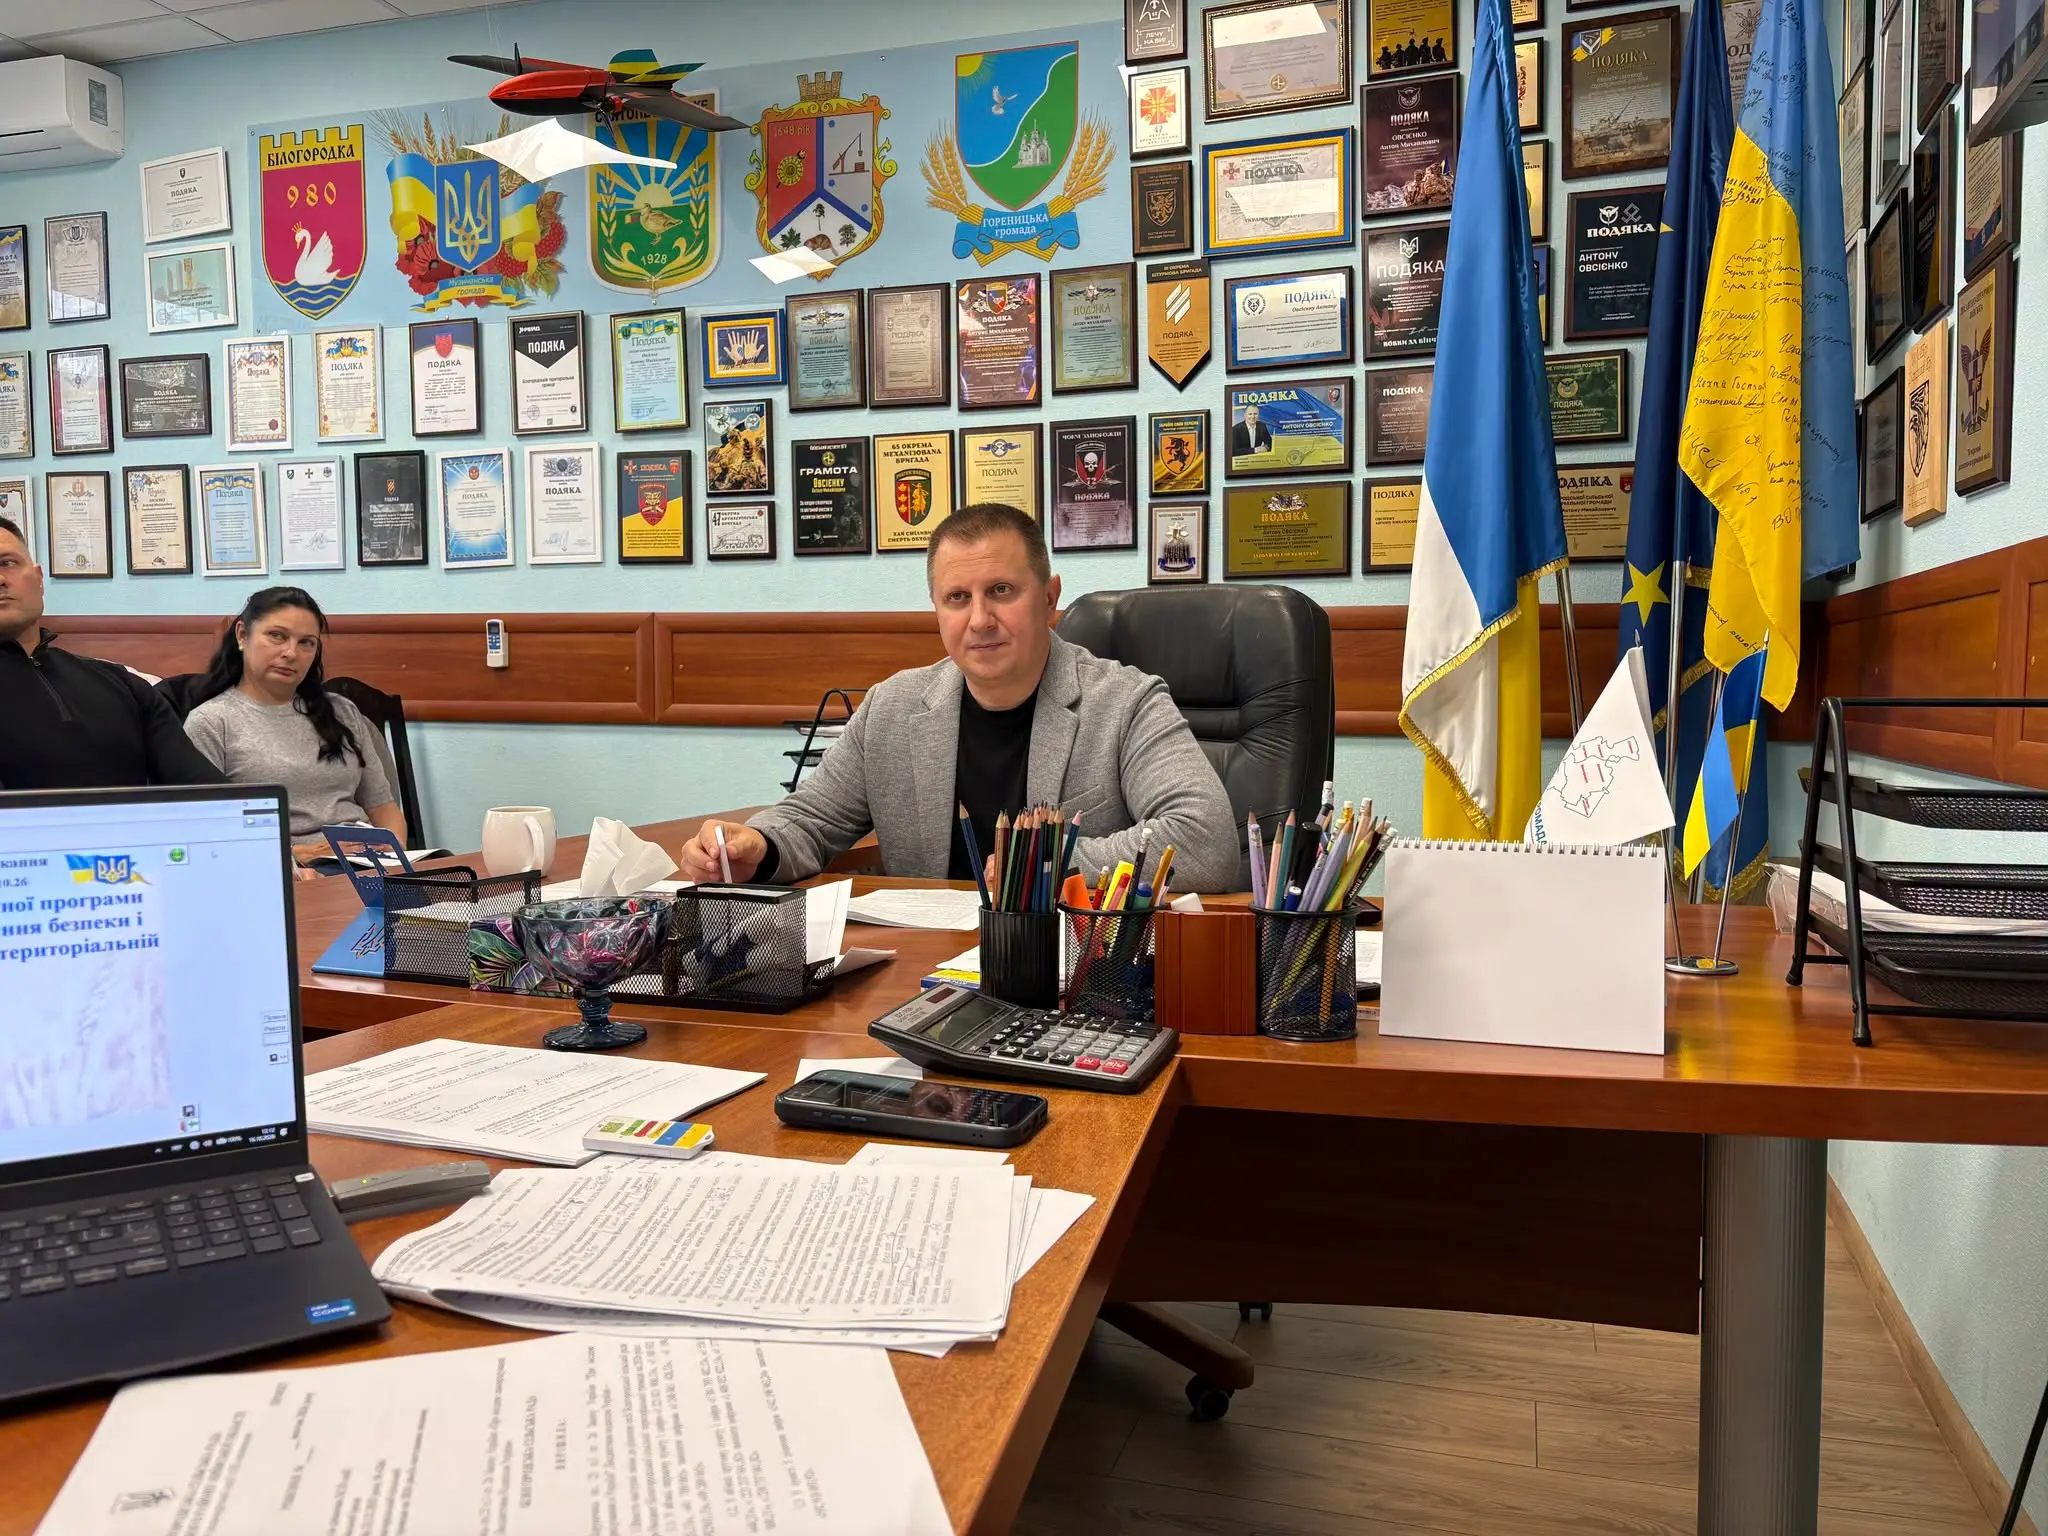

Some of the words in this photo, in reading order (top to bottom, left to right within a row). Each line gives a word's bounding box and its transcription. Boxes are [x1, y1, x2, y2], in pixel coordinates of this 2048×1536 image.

[1590, 50, 1649, 69] ПОДЯКА
[1390, 111, 1430, 126] ПОДЯКА
[774, 125, 795, 137] 1648
[1391, 131, 1428, 141] ОВСІЄНКО
[266, 143, 356, 168] БІЛОГОРОДКА
[1244, 164, 1305, 180] ПОДЯКА
[170, 184, 198, 199] ПОДЯКА
[286, 180, 338, 209] 980
[982, 212, 1049, 229] ГОРЕНИЦЬКА
[995, 224, 1037, 237] громада
[1586, 223, 1656, 238] ПОДЯКА
[640, 252, 668, 266] 1928
[1579, 251, 1619, 262] АНТОНУ
[1376, 260, 1445, 279] ПОДЯКА
[1578, 262, 1628, 273] ОВСІЄНКО
[457, 287, 486, 296] громада
[1284, 289, 1337, 304] ПОДЯКА
[982, 315, 1013, 324] ПОДЯКА
[631, 335, 667, 347] Подяка
[1163, 330, 1194, 340] ПОДЯКА
[1418, 336, 1437, 344] ВІНЧ
[527, 339, 566, 354] ПОДЯКА
[331, 362, 364, 373] ПОДЯКА
[427, 359, 462, 369] ПОДЯКА
[1238, 390, 1299, 404] ПОДЯКА
[1382, 386, 1424, 397] ПОДЯКА
[1553, 400, 1583, 409] ПОДЯКА
[800, 466, 858, 476] ГРАМОТА
[981, 467, 1018, 478] ПОДЯКА
[1558, 476, 1614, 490] ОДЯКА
[216, 489, 244, 499] Подяка
[462, 492, 489, 501] ПОДЯКА
[545, 487, 582, 496] ПОДЯКА
[1074, 491, 1111, 501] ПОДЯКА
[1373, 490, 1415, 500] ПОДЯКА
[1261, 511, 1310, 523] ПОДЯКА
[0, 856, 49, 870] кання
[0, 896, 35, 914] ної
[39, 892, 144, 917] програми
[0, 920, 43, 938] ння
[47, 913, 131, 935] безпеки
